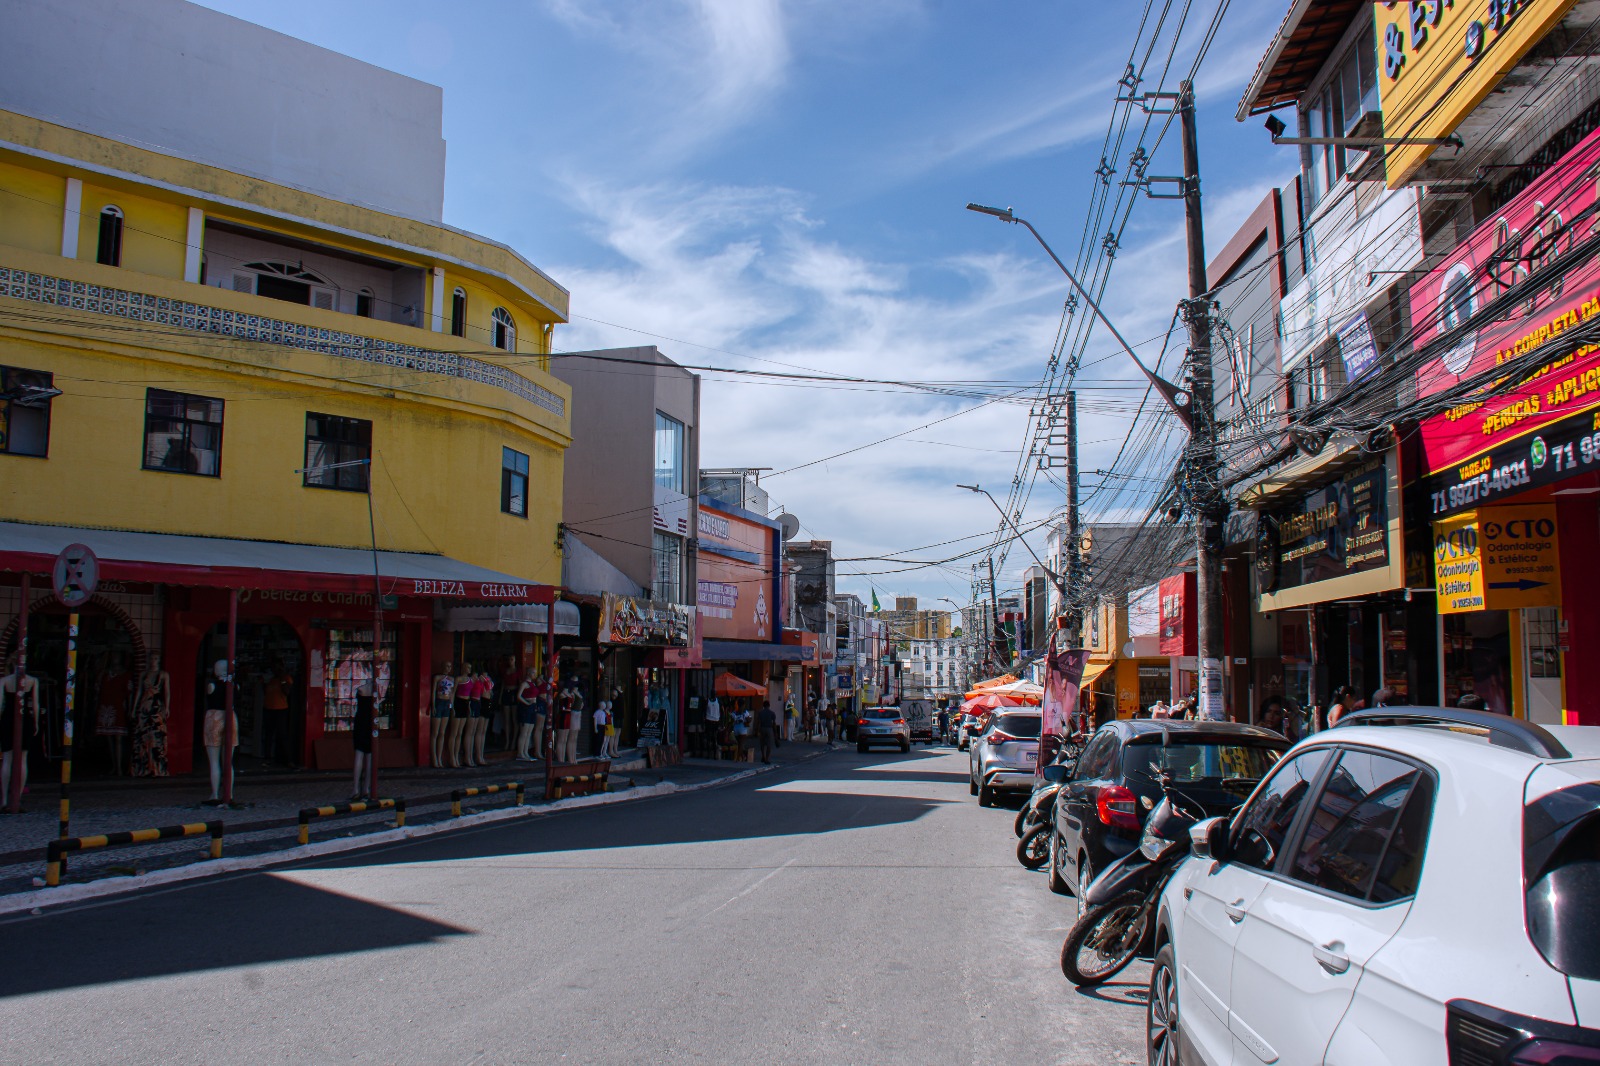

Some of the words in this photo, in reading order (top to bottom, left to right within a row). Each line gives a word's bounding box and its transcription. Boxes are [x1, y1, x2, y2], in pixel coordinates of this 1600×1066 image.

[1408, 0, 1453, 53] ES
[1514, 308, 1579, 357] COMPLETA
[1547, 367, 1600, 405] #APLIQ
[1431, 490, 1448, 514] 71
[1449, 459, 1531, 508] 99273-4631
[1552, 442, 1577, 472] 71
[1459, 456, 1492, 480] VAREJO
[1505, 518, 1555, 539] CTO
[1487, 541, 1552, 552] Odontologia
[1438, 560, 1479, 578] Odontologia
[1498, 554, 1538, 564] Estética
[260, 590, 307, 602] Beleza
[312, 592, 323, 603] &
[329, 592, 372, 606] Charm
[414, 580, 465, 595] BELEZA
[481, 584, 528, 597] CHARM
